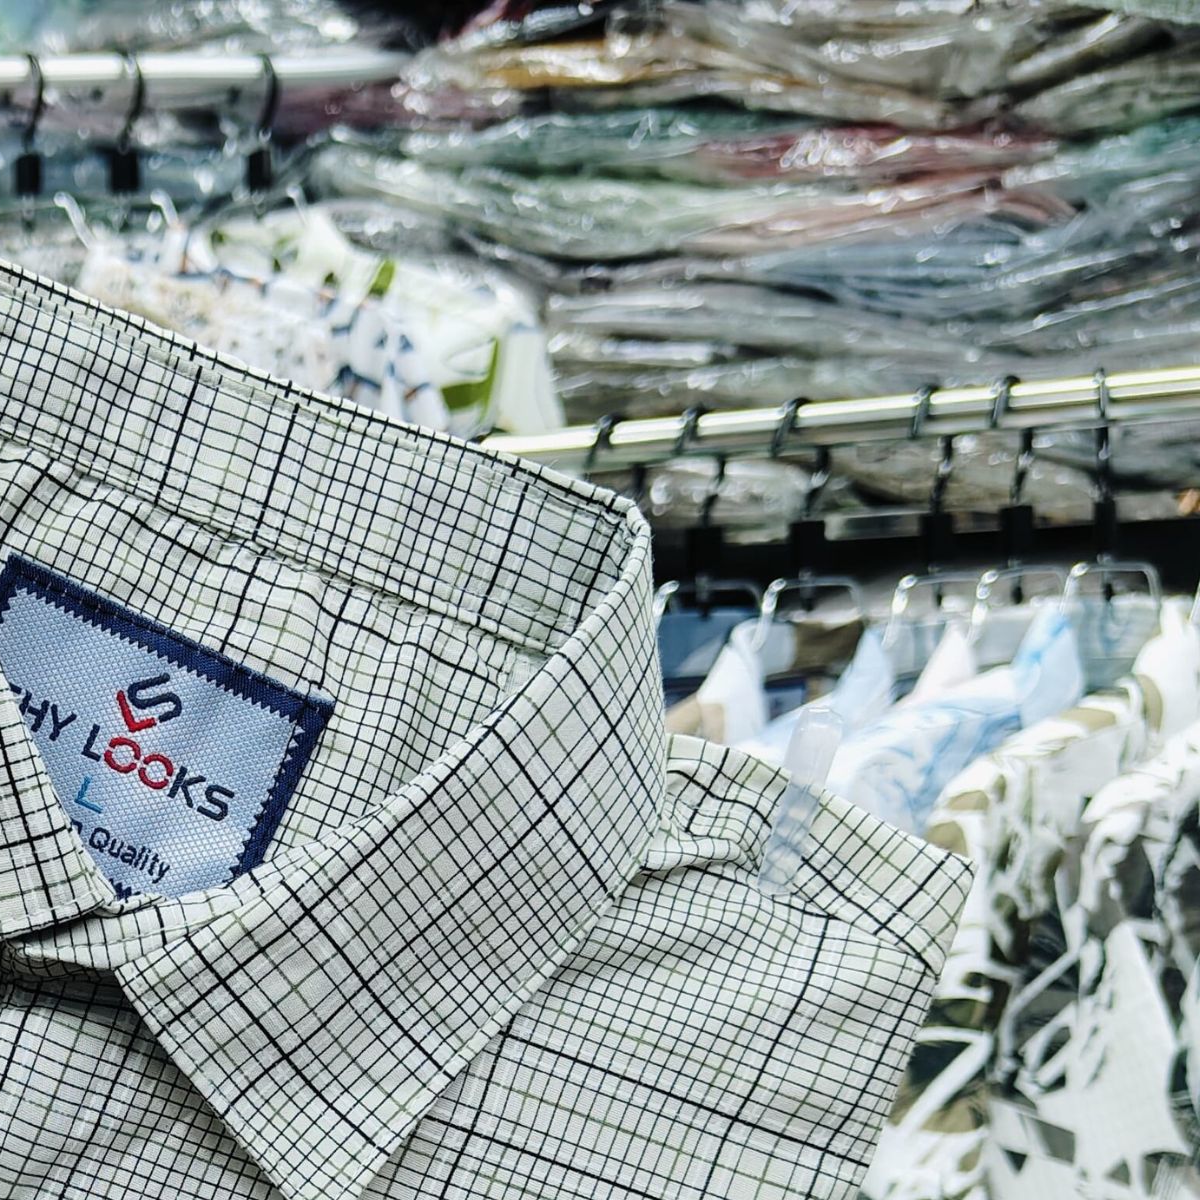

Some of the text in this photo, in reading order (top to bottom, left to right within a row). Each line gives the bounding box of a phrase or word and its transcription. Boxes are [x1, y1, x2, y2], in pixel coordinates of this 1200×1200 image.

[74, 775, 104, 814] L
[81, 723, 236, 822] LOOKS
[88, 826, 171, 884] Quality
